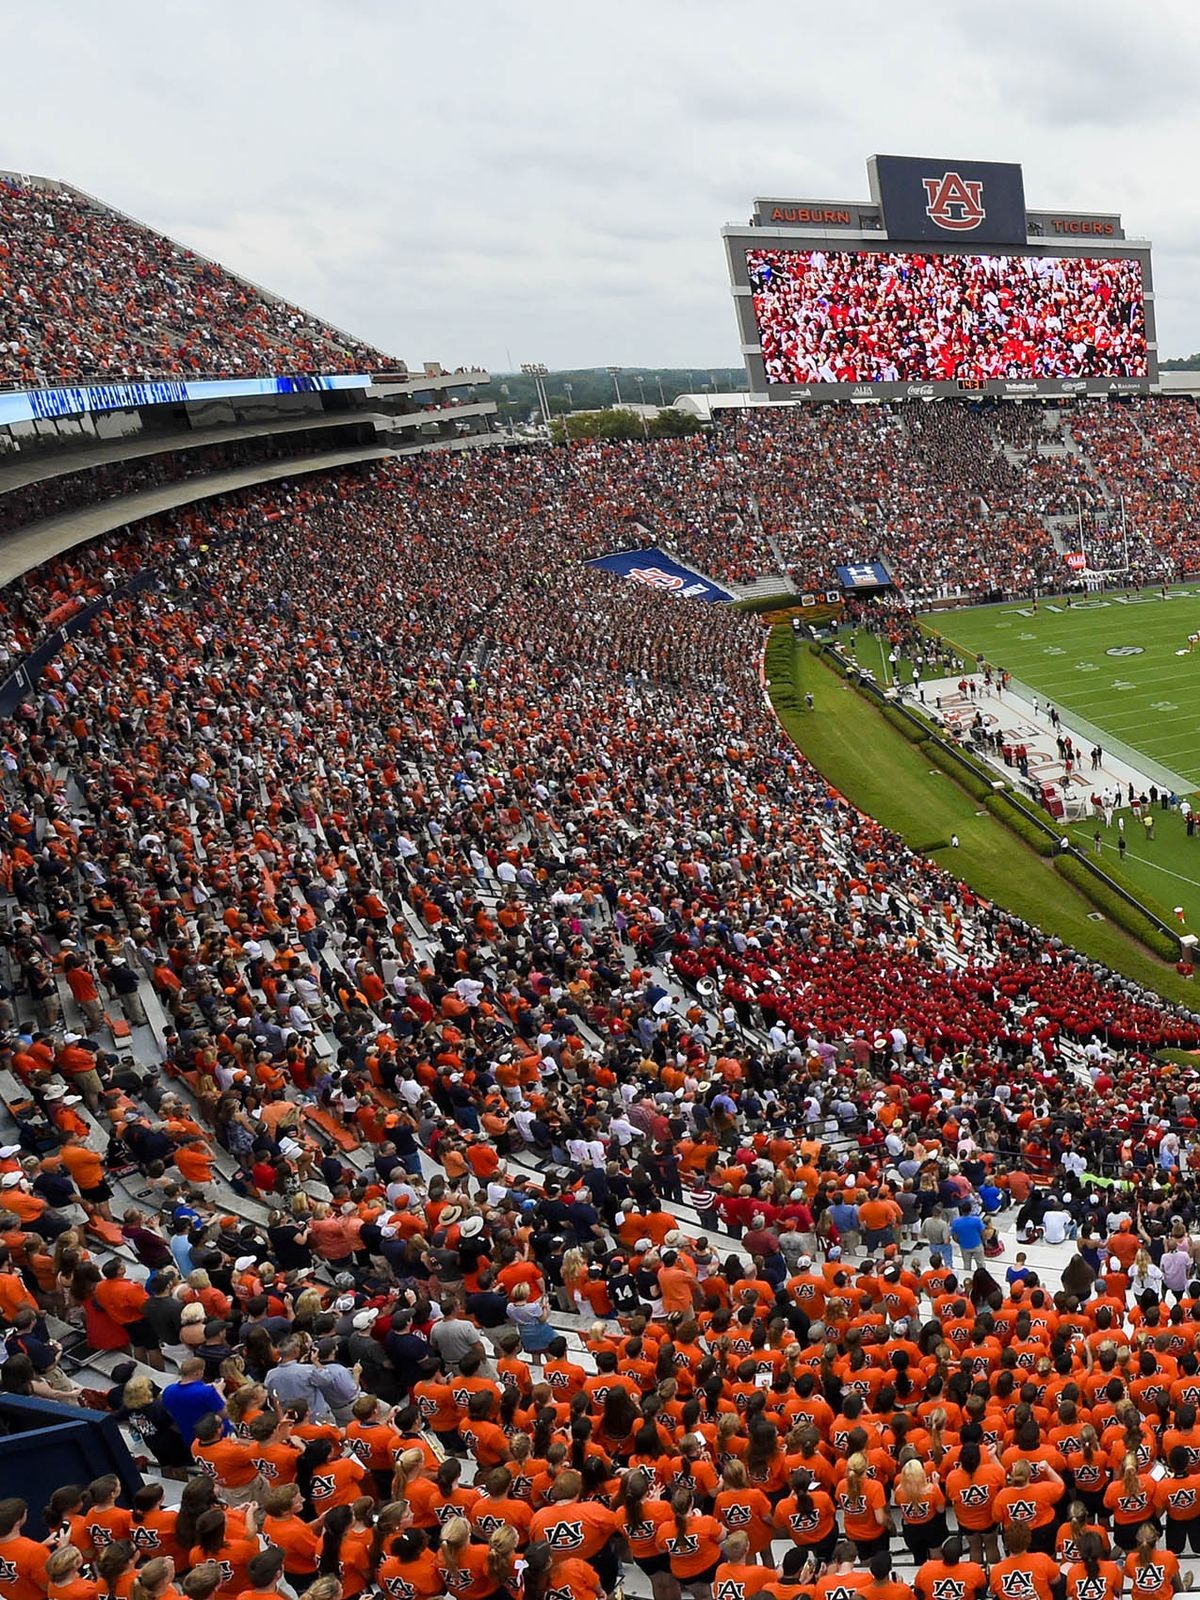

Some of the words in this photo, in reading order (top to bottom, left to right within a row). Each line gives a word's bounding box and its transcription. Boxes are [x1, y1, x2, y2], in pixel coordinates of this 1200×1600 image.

[770, 207, 851, 225] AUBURN
[1052, 219, 1115, 236] TIGERS
[615, 1284, 633, 1301] 14
